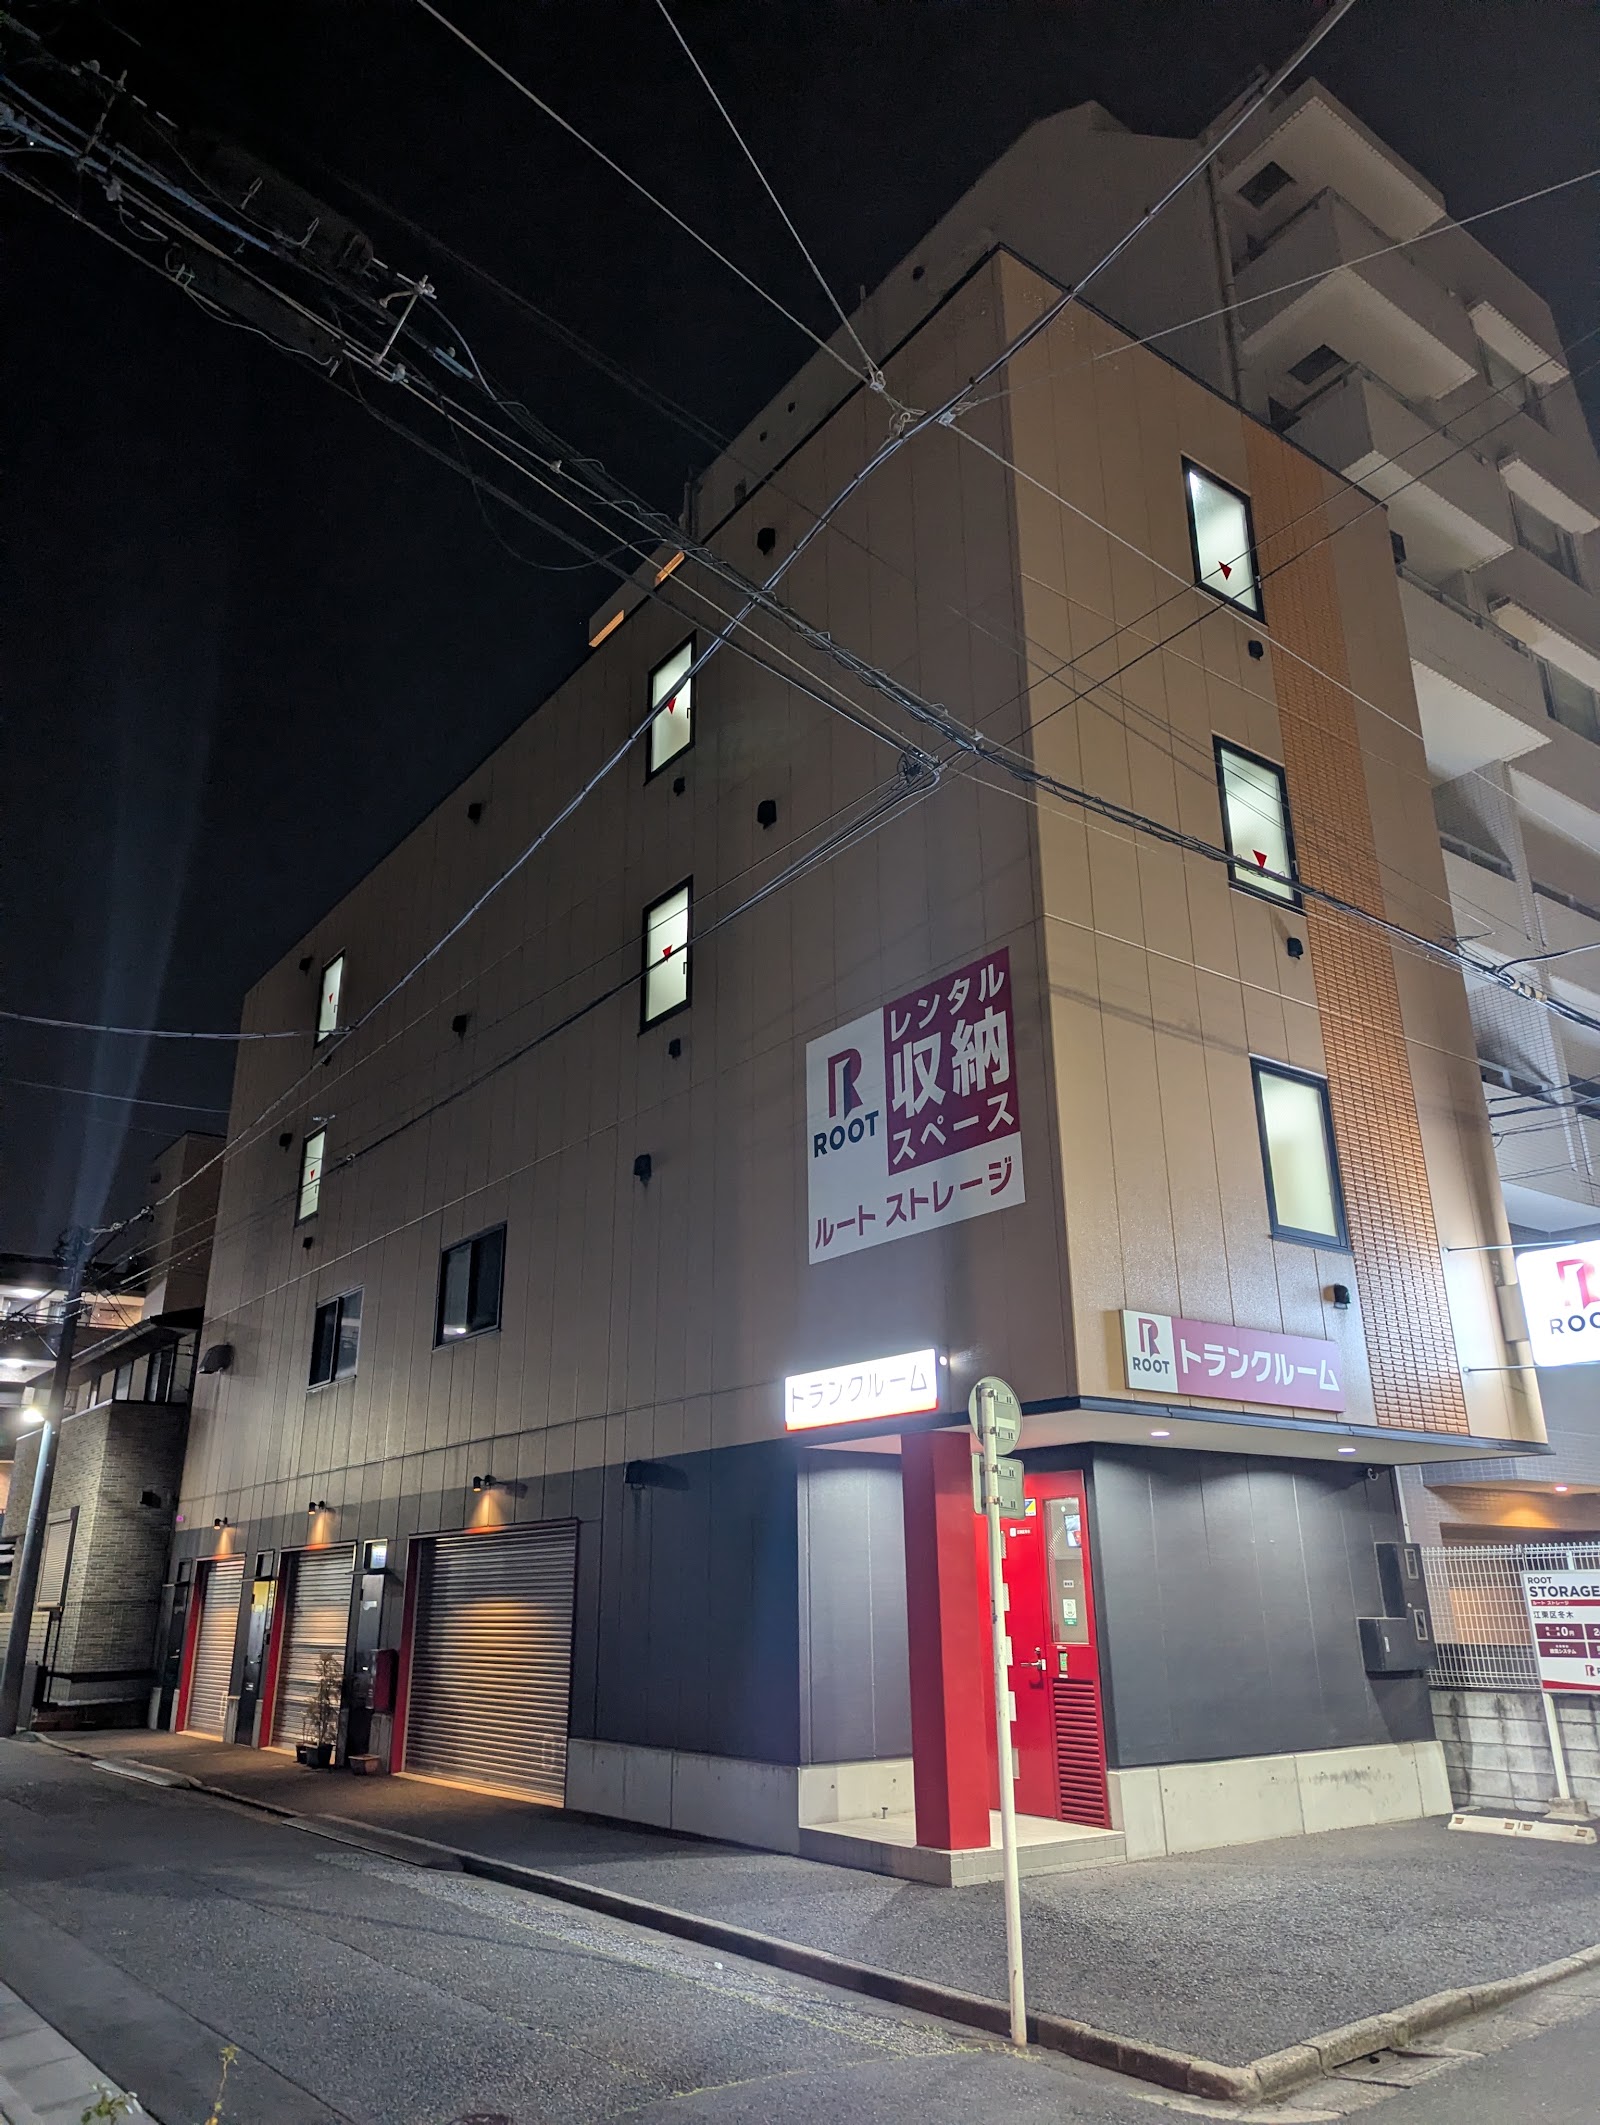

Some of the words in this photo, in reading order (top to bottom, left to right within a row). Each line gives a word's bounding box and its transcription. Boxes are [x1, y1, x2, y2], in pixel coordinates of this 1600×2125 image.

[890, 963, 1005, 1041] レンタル
[891, 1005, 1011, 1119] 収納
[813, 1110, 879, 1158] ROOT
[892, 1092, 1014, 1166] スペース
[815, 1204, 876, 1250] ルート
[886, 1156, 1013, 1228] ストレージ
[791, 1364, 928, 1413] トランクルーム
[1132, 1356, 1170, 1375] ROOT
[1179, 1338, 1341, 1392] トランクルーム
[1527, 1576, 1552, 1584] ROOT
[1529, 1585, 1600, 1597] STORAGE
[1533, 1610, 1574, 1619] 江東区冬木
